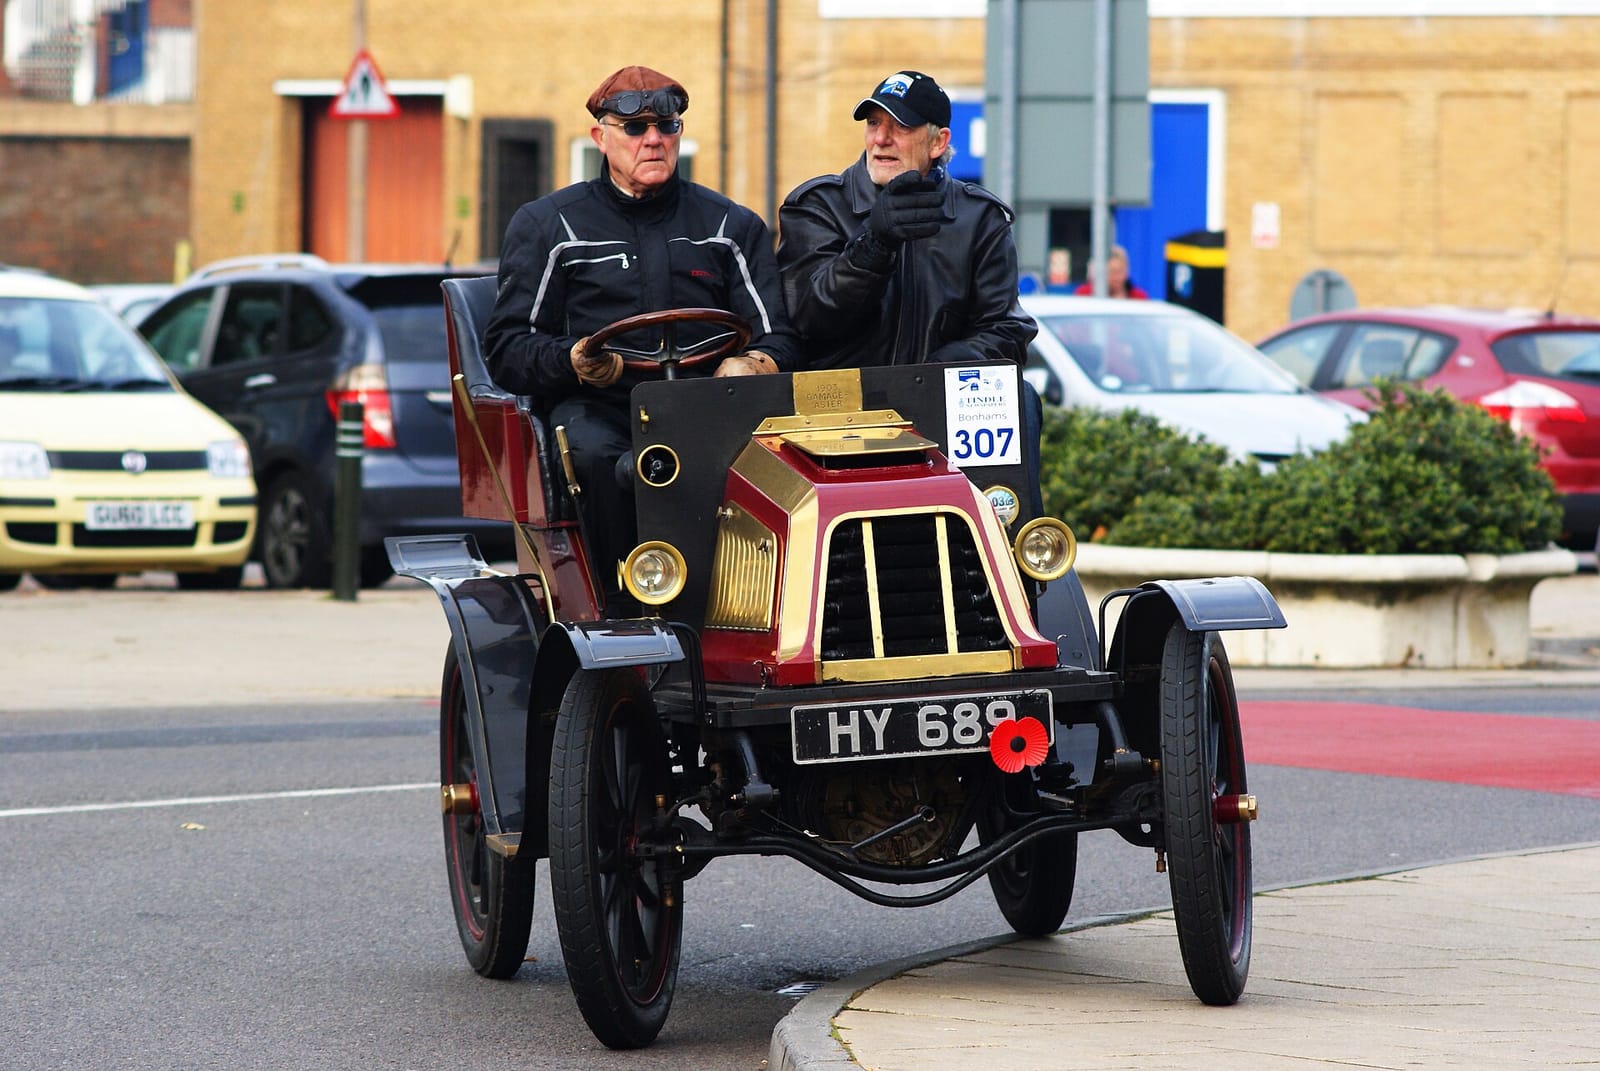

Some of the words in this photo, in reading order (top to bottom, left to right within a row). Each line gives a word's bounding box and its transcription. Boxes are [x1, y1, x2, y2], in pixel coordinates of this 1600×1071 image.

[958, 413, 1007, 422] Bonhams
[954, 428, 1013, 459] 307
[828, 708, 892, 754] HY
